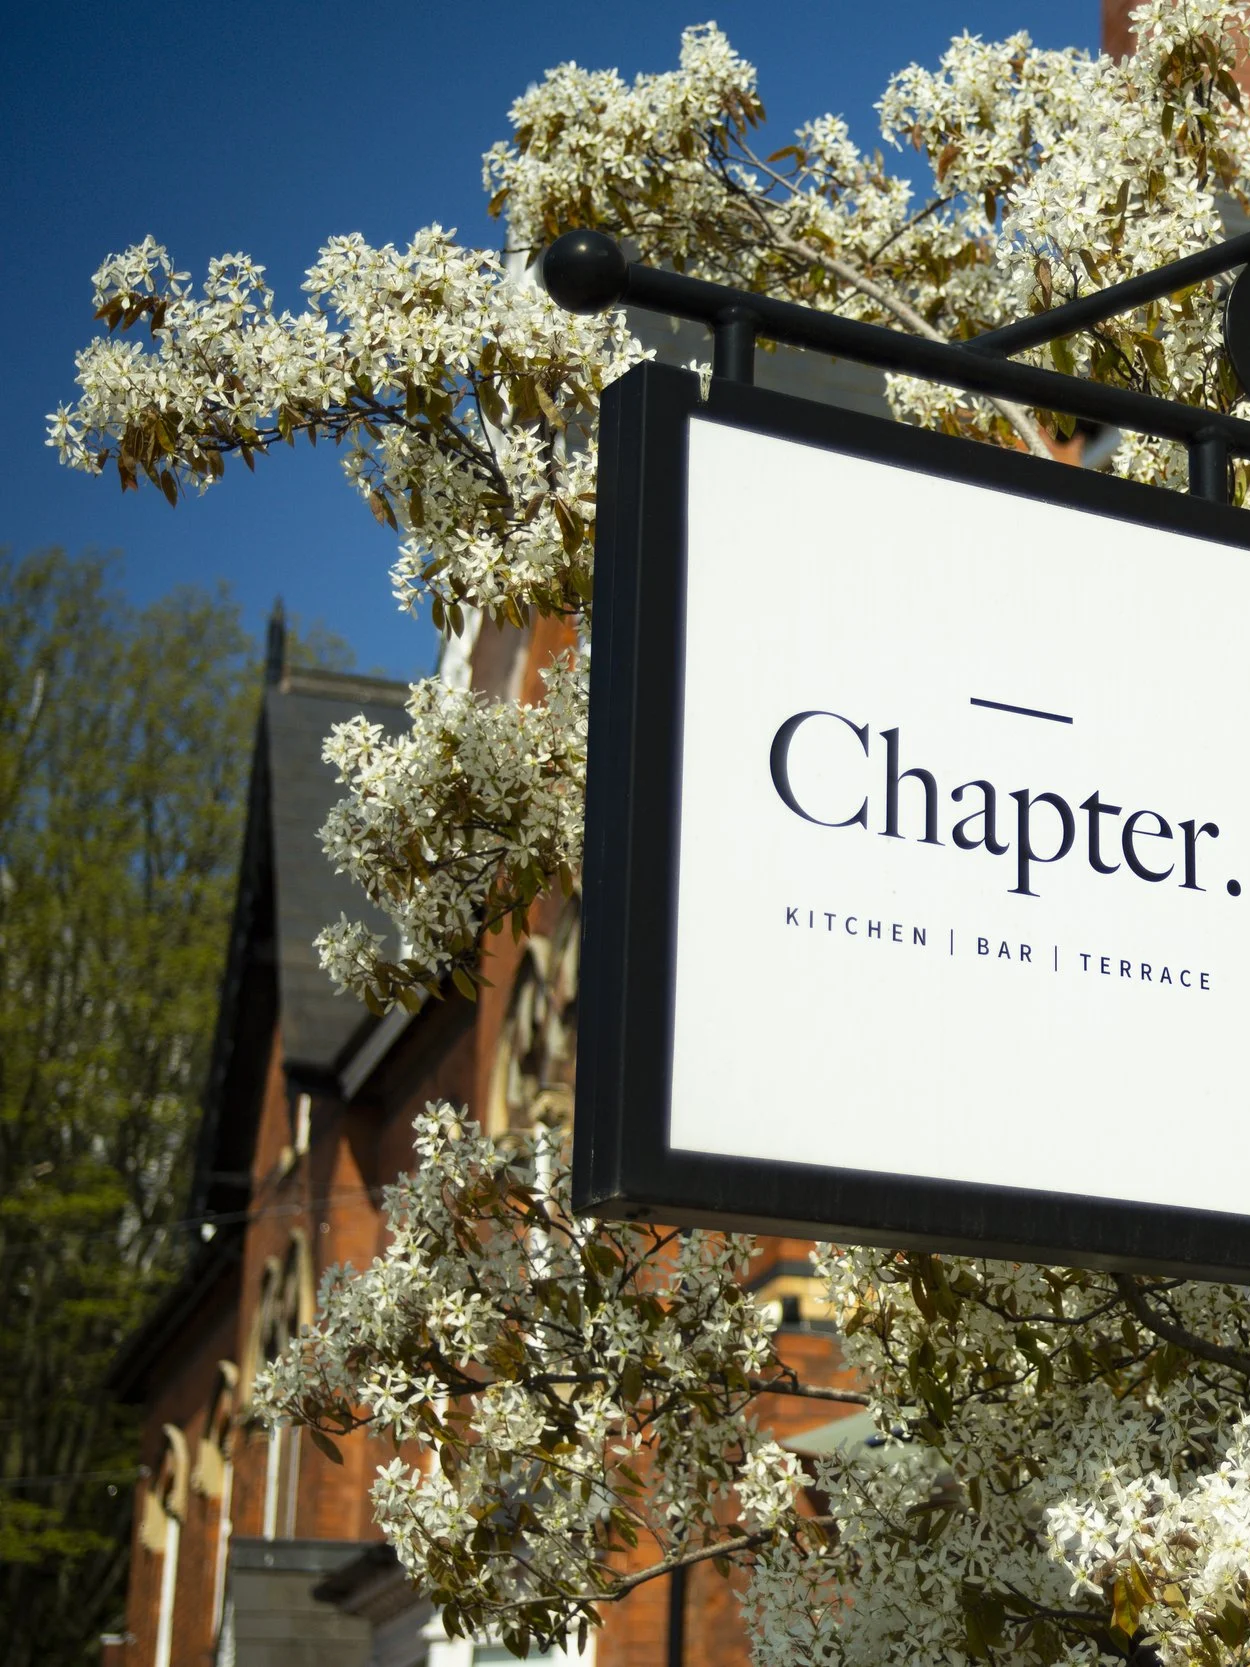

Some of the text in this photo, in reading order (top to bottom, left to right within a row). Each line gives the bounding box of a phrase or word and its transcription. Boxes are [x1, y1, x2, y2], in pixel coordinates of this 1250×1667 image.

[769, 710, 1242, 897] Chapter.
[785, 906, 1211, 991] KITCHEN BAR TERRACE
